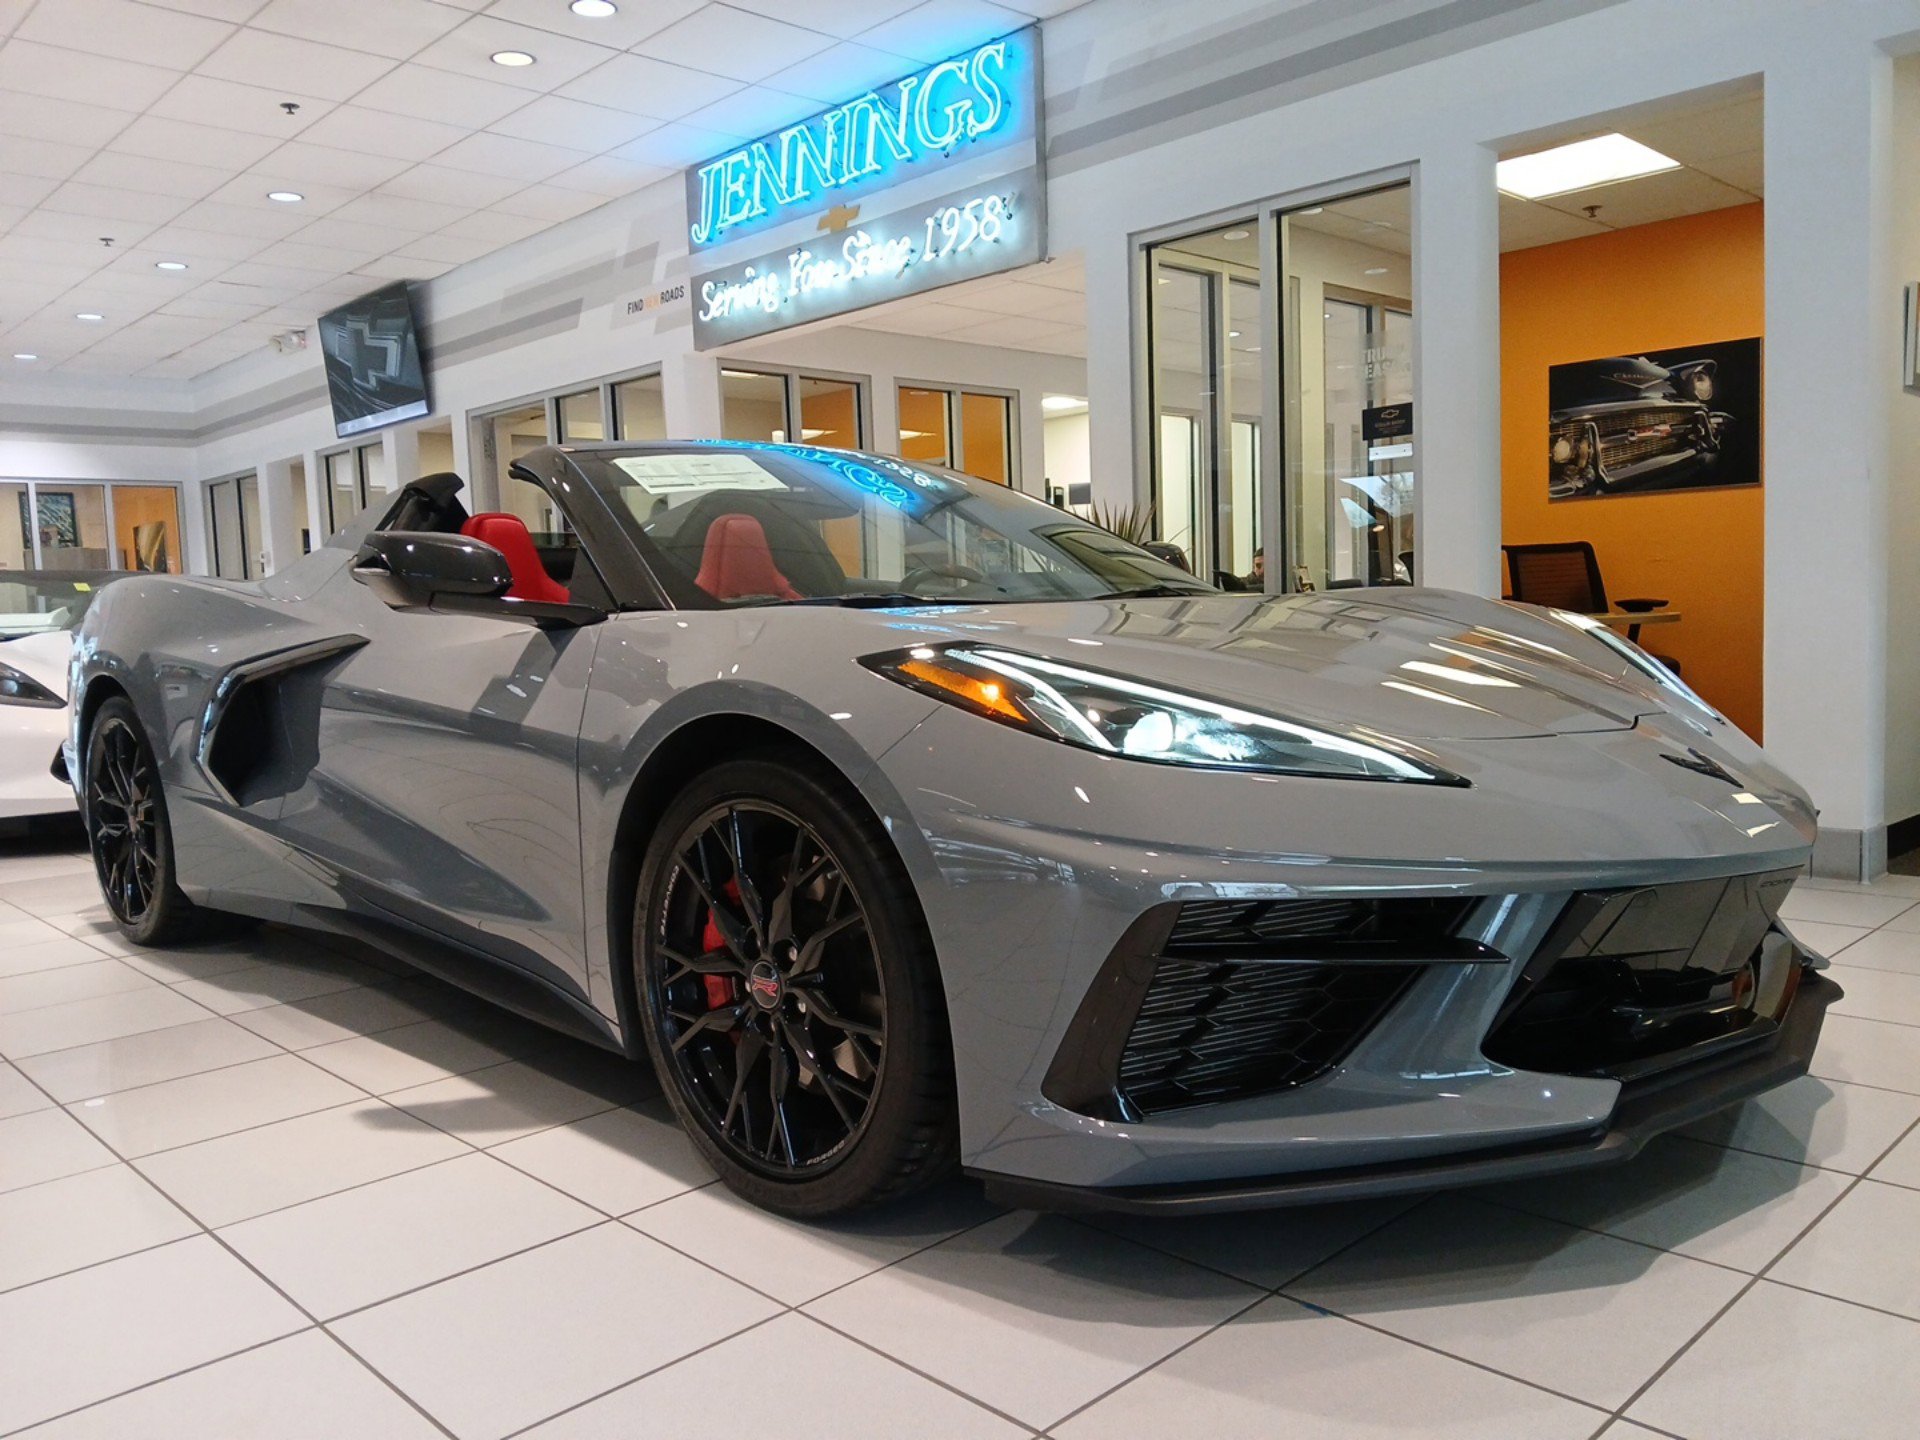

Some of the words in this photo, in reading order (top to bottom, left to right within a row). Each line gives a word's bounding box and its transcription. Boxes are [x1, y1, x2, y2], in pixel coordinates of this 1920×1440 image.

[691, 41, 1006, 244] JENNINGS
[698, 265, 781, 322] Serving
[923, 194, 1001, 262] 1958
[627, 298, 644, 315] FIND
[660, 285, 685, 304] ROADS
[806, 1139, 845, 1166] FORGED
